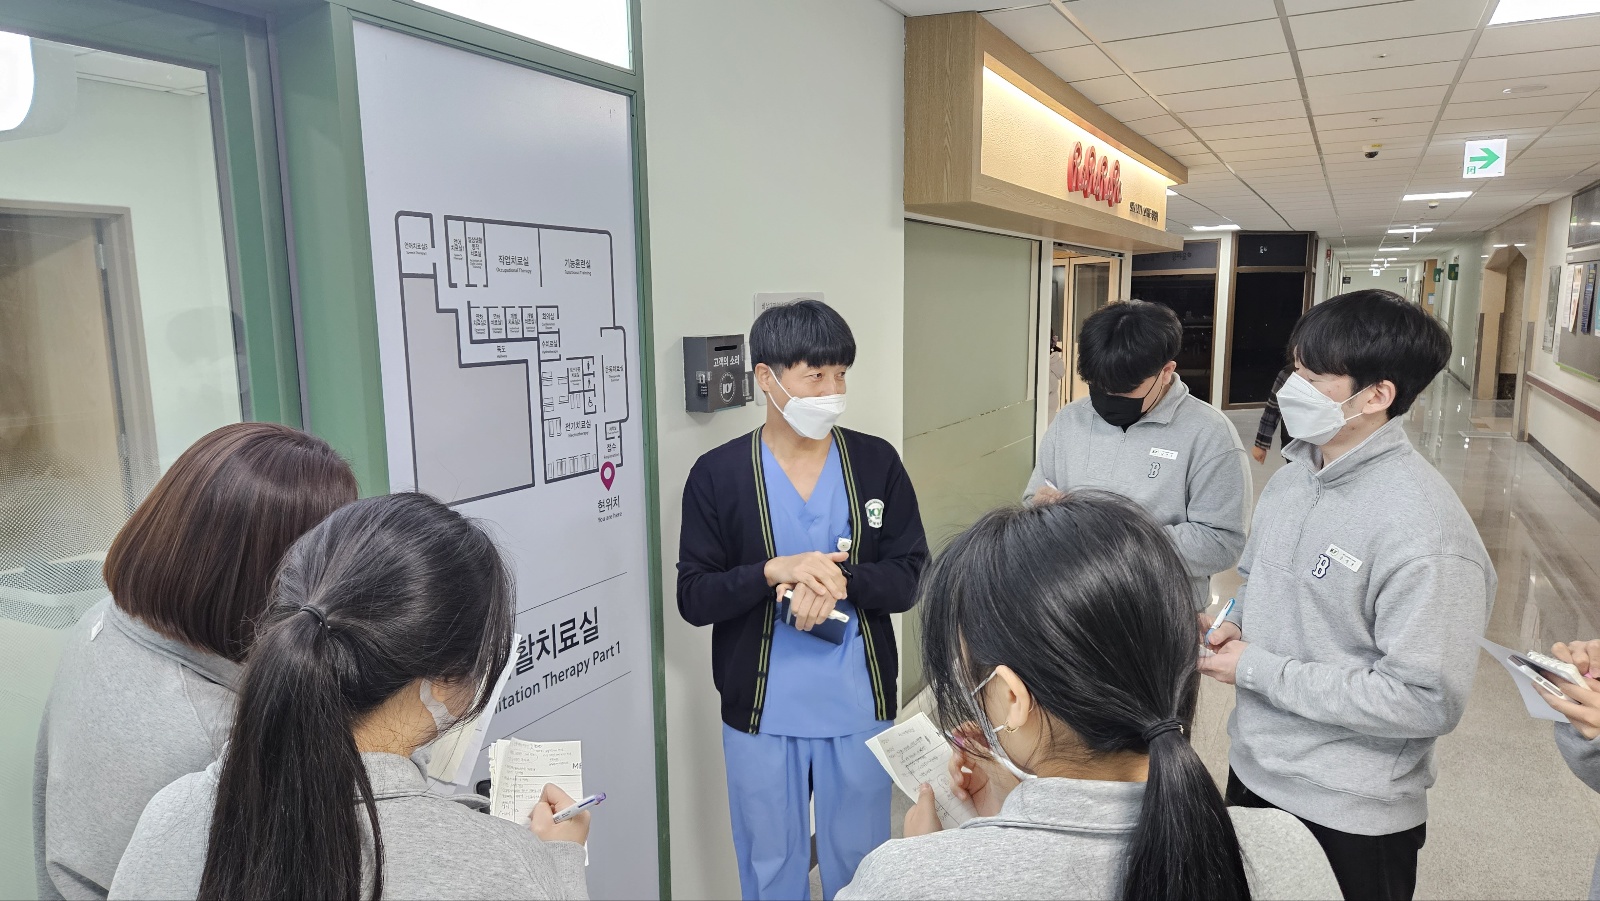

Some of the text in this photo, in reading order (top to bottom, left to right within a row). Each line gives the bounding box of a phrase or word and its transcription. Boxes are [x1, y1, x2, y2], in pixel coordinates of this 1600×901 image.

[498, 255, 530, 266] 작업치료실
[564, 258, 591, 269] 기능훈련실
[713, 354, 740, 368] 고객의 소리
[564, 419, 592, 432] 전기치료실
[606, 442, 617, 453] 접수
[1147, 461, 1162, 479] B
[597, 494, 621, 513] 현위치
[612, 511, 623, 519] here
[1311, 553, 1331, 579] B
[508, 606, 599, 681] 활치료실
[542, 657, 591, 690] Therapy
[592, 644, 615, 666] Part
[615, 640, 621, 654] 1
